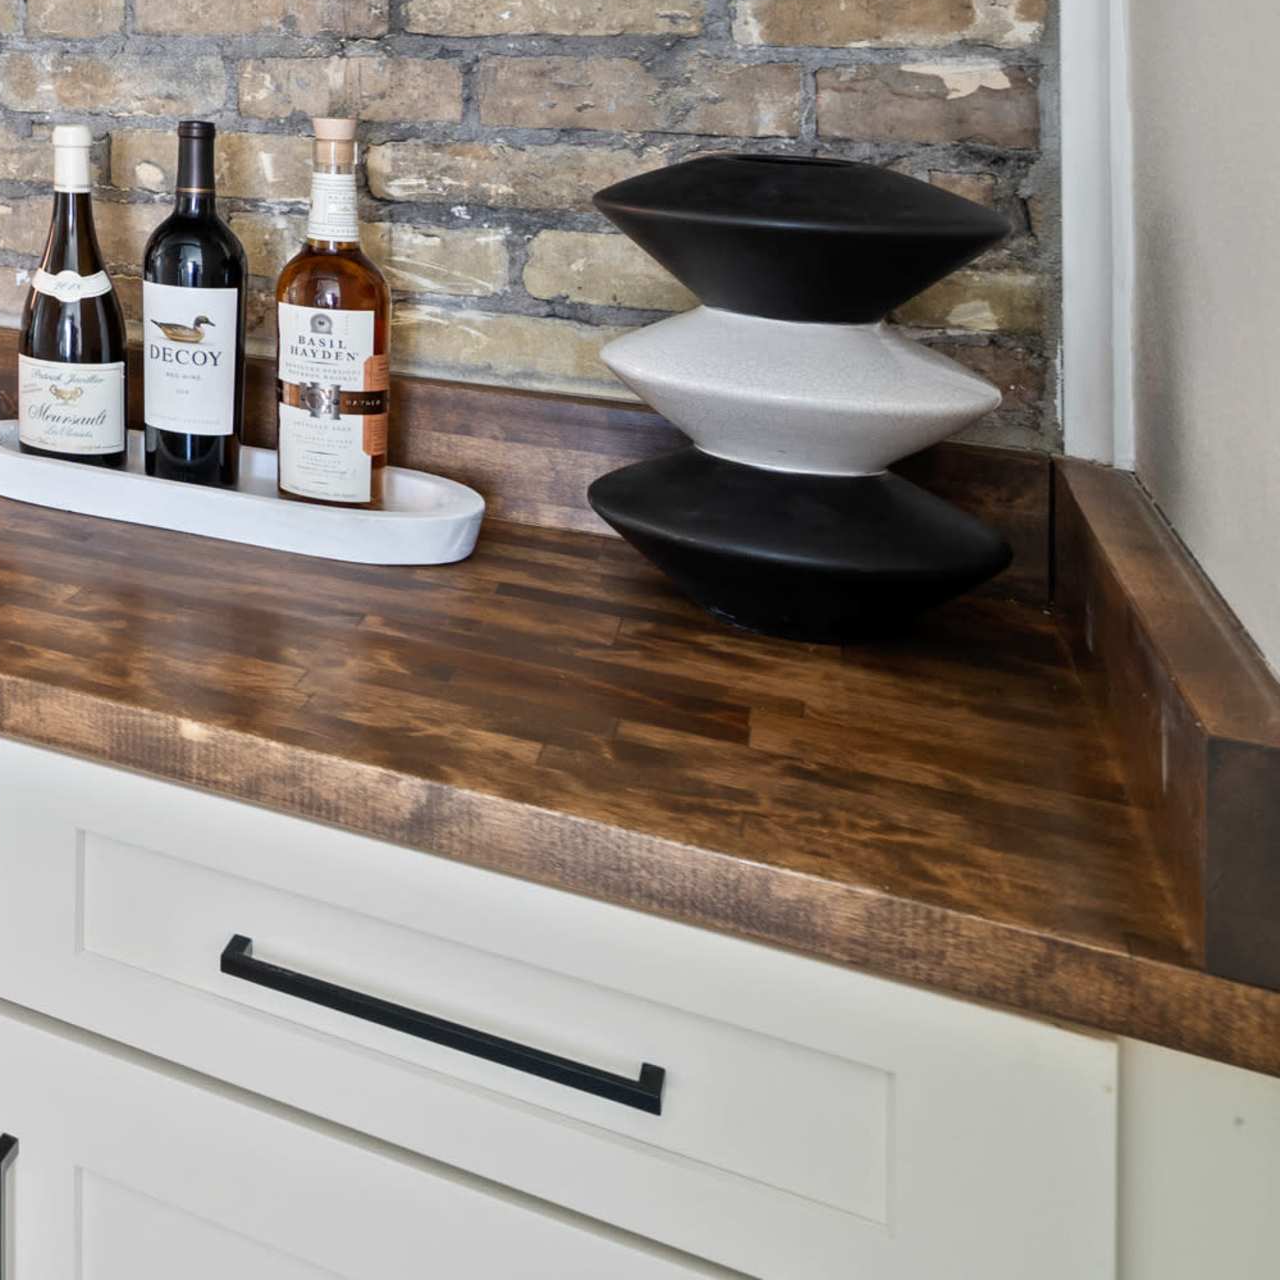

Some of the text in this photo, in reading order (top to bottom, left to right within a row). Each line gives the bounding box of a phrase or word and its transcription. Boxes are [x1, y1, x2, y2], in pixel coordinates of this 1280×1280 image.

[298, 335, 346, 350] BASIL
[150, 344, 222, 367] DECOY
[289, 344, 356, 361] HAYDEN
